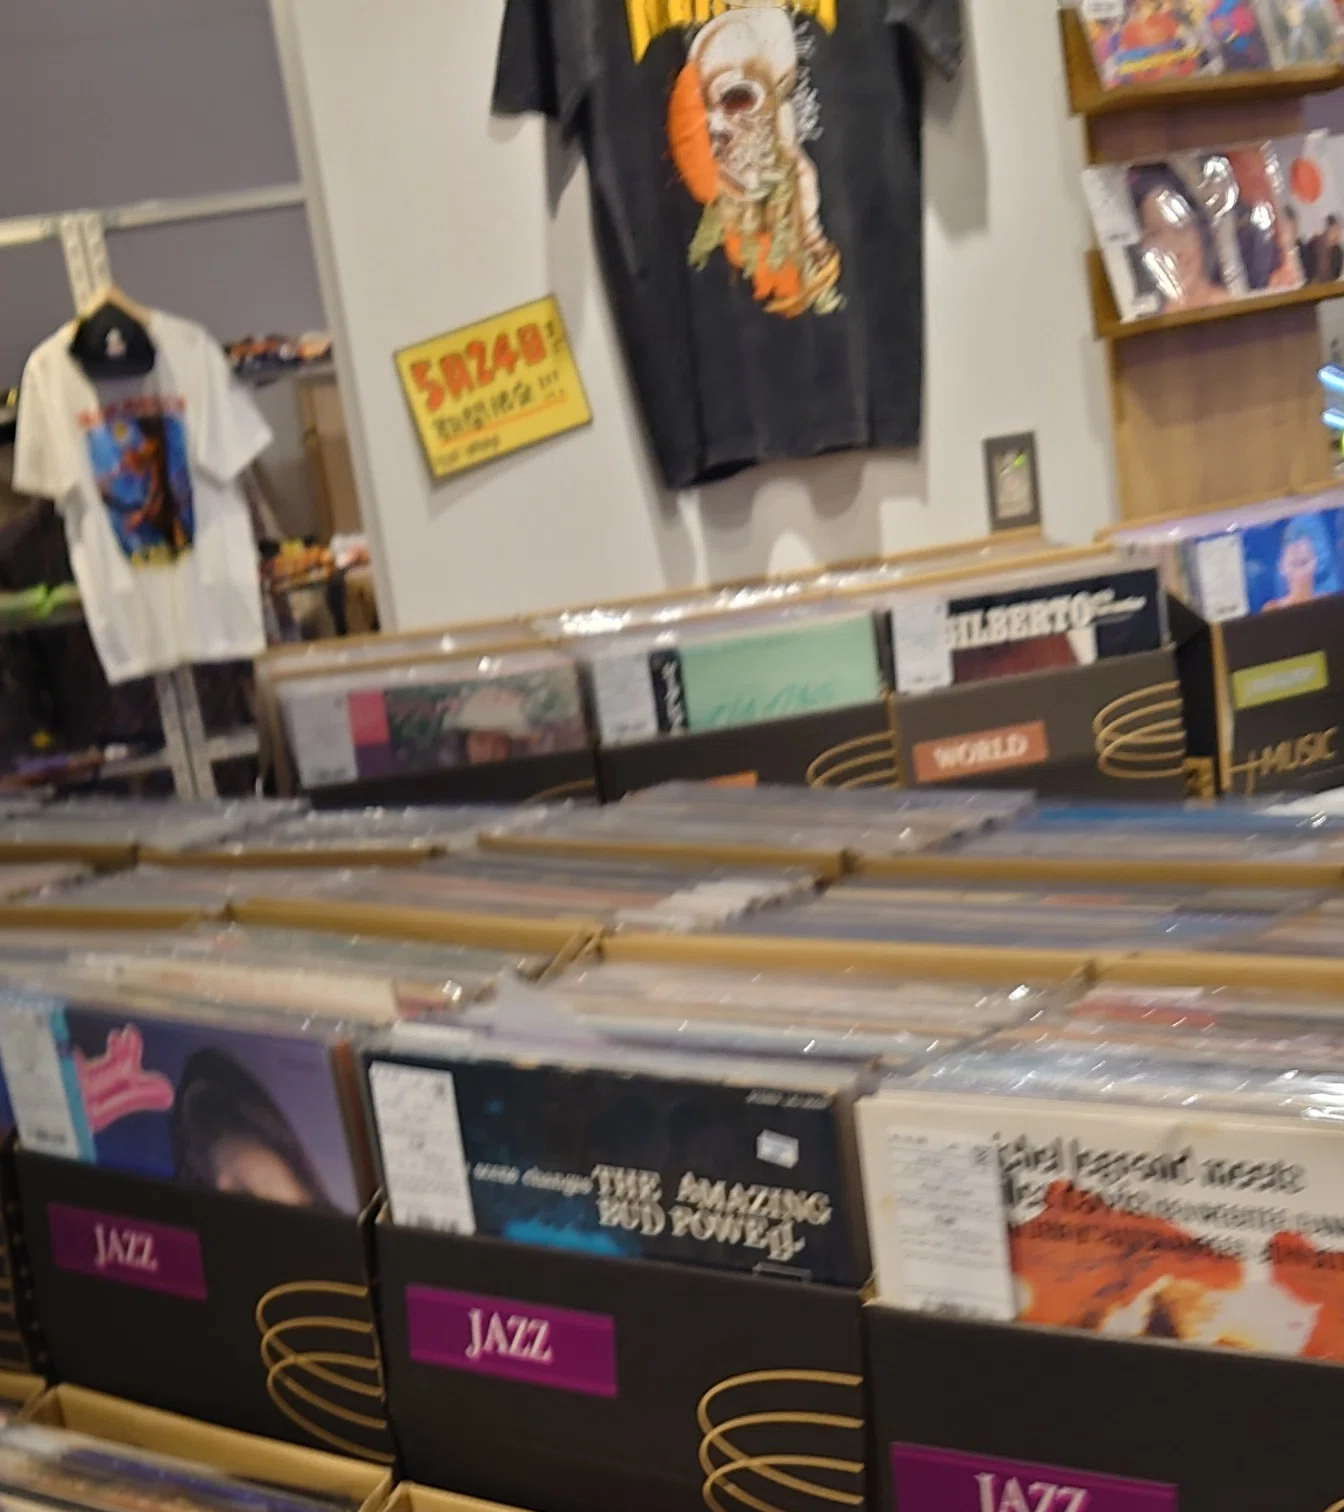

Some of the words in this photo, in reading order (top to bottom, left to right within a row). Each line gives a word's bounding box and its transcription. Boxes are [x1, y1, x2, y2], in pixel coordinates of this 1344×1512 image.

[932, 732, 1030, 769] WORLD
[592, 1162, 663, 1201] THE
[677, 1170, 833, 1226] AMAZING
[93, 1224, 159, 1270] JAZZ
[596, 1197, 666, 1237] BUD
[668, 1205, 807, 1262] POWELL
[465, 1307, 554, 1364] JAZZ
